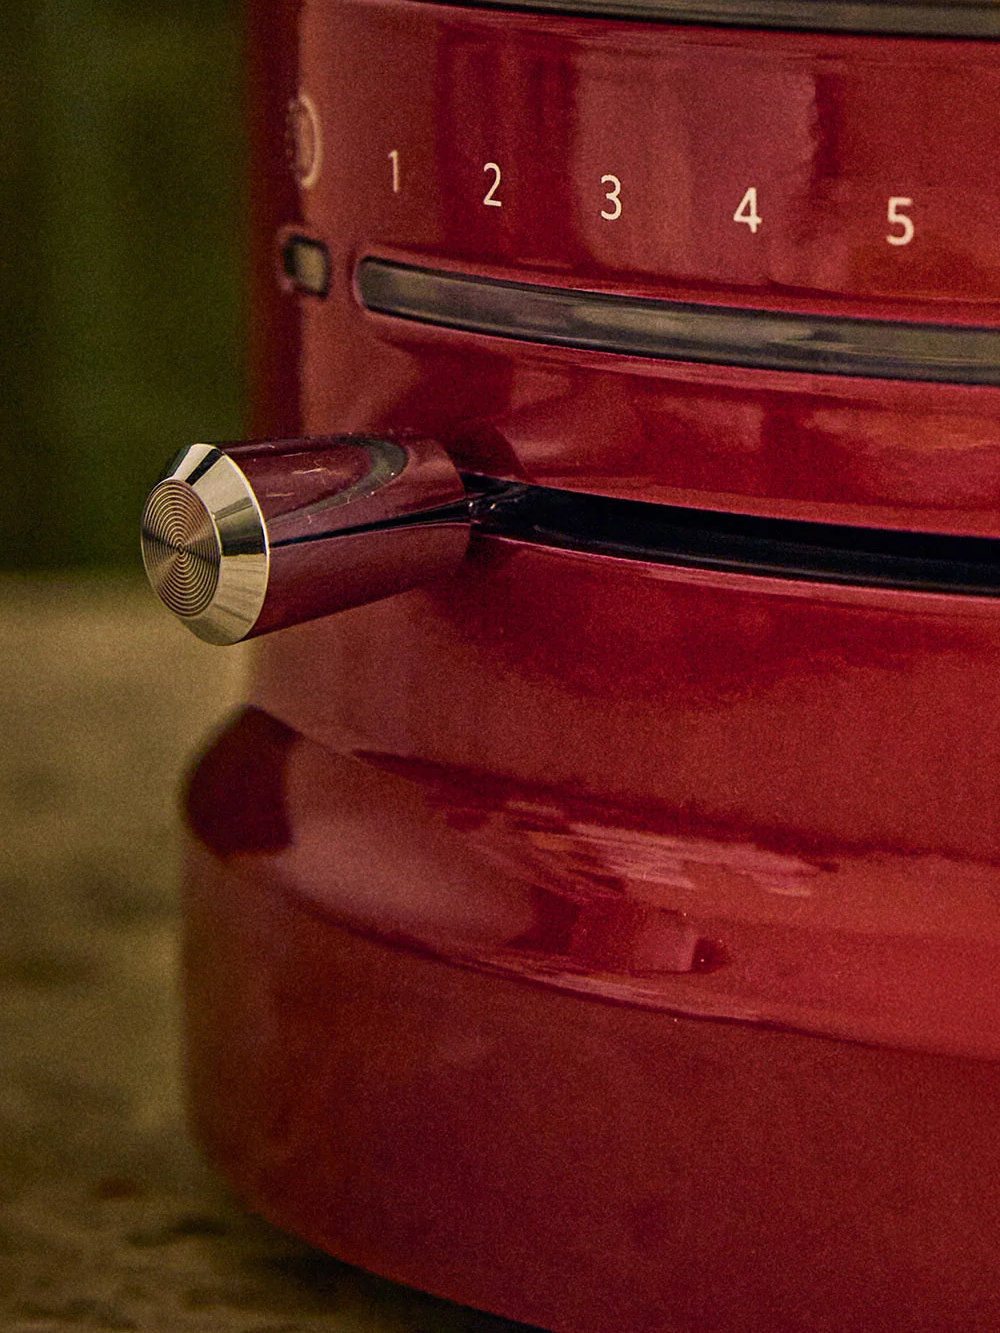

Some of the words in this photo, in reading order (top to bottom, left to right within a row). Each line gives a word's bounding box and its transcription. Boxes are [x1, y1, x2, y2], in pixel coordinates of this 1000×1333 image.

[387, 150, 400, 193] 1
[483, 162, 502, 207] 2
[600, 174, 622, 221] 3
[732, 187, 762, 233] 4
[885, 197, 915, 246] 5
